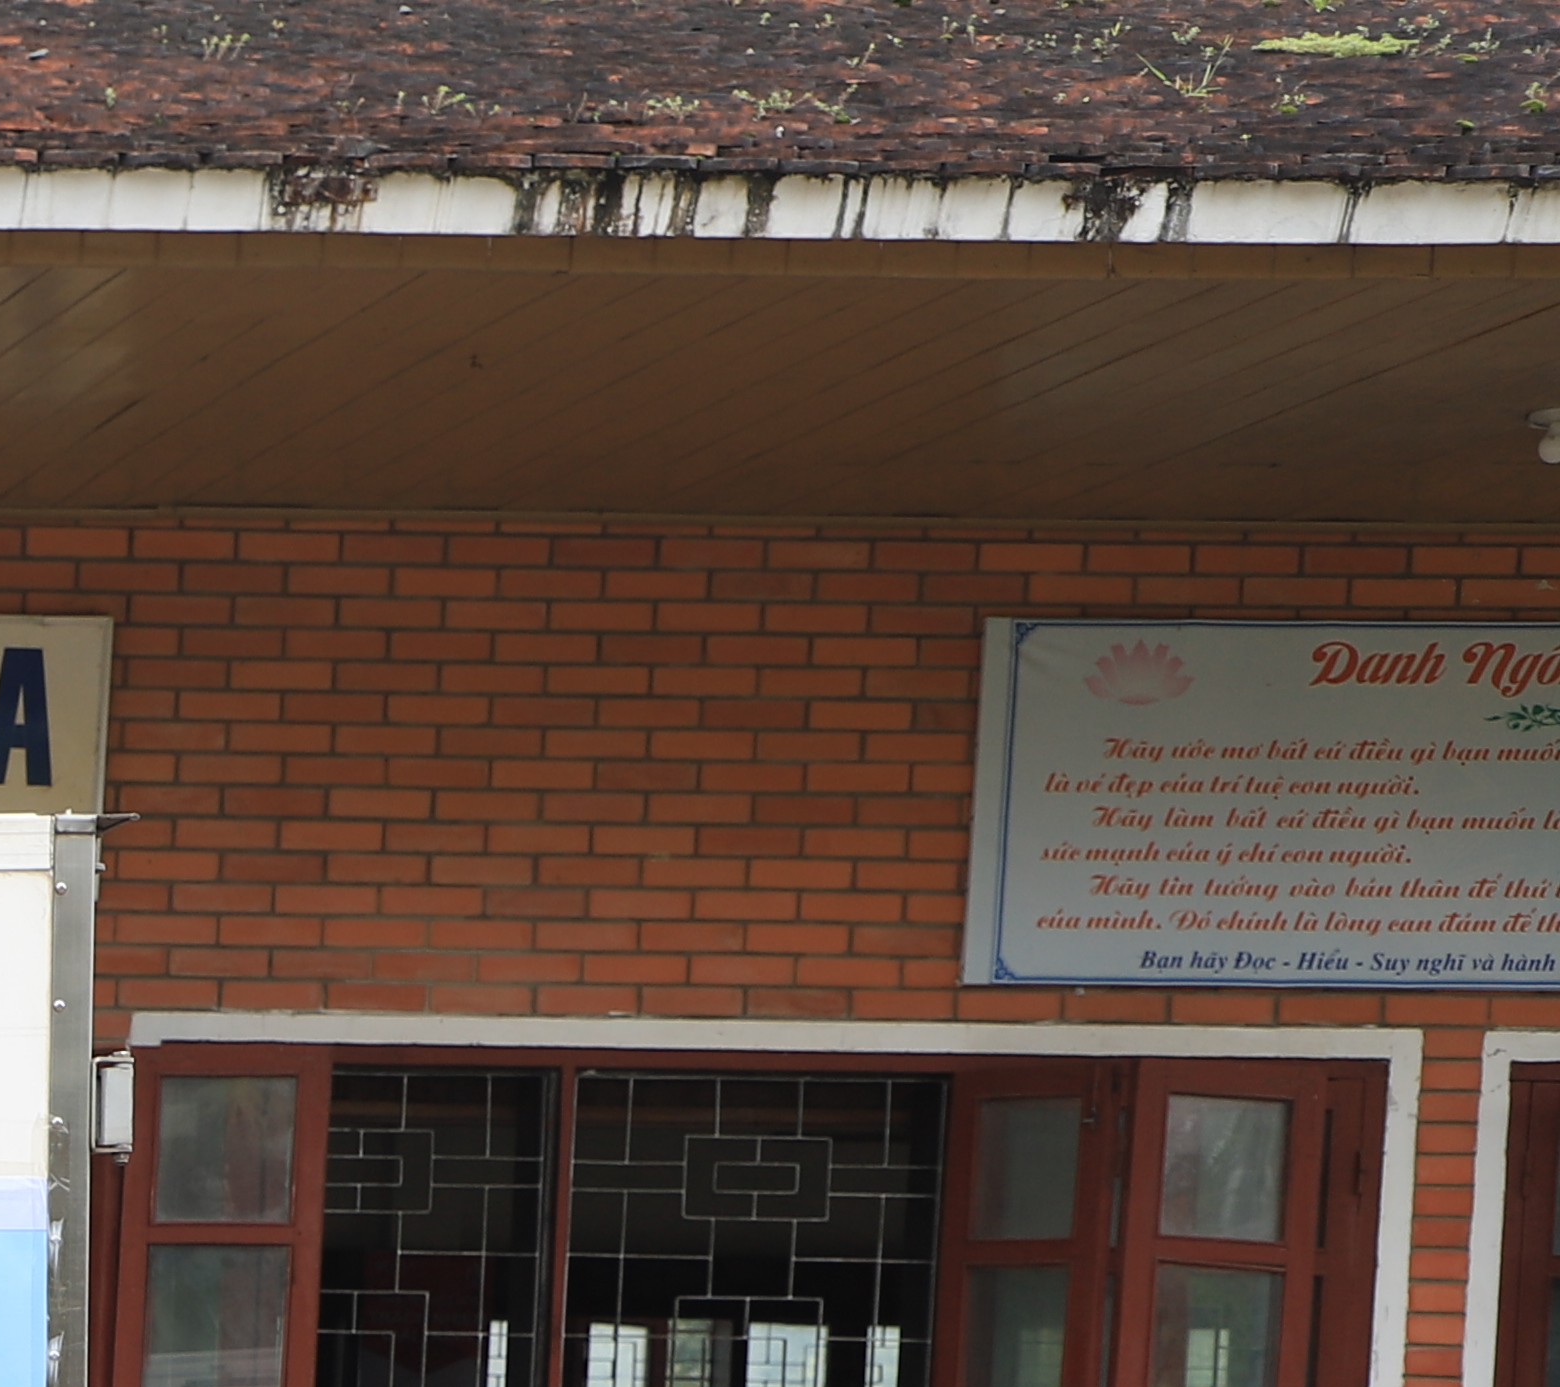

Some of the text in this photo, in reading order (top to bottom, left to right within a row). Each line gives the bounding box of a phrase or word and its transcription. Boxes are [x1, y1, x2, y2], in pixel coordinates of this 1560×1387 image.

[1309, 641, 1447, 686] Danh
[1104, 738, 1164, 762] Hãy
[1410, 742, 1437, 765] gì
[1442, 741, 1490, 766] bạn
[1044, 772, 1070, 792] là
[1108, 772, 1154, 798] đẹp
[1210, 775, 1244, 793] trí
[1289, 781, 1331, 794] con
[1140, 949, 1556, 976] Bạn hãy Đọc Hiểu Suy nghĩ và hành
